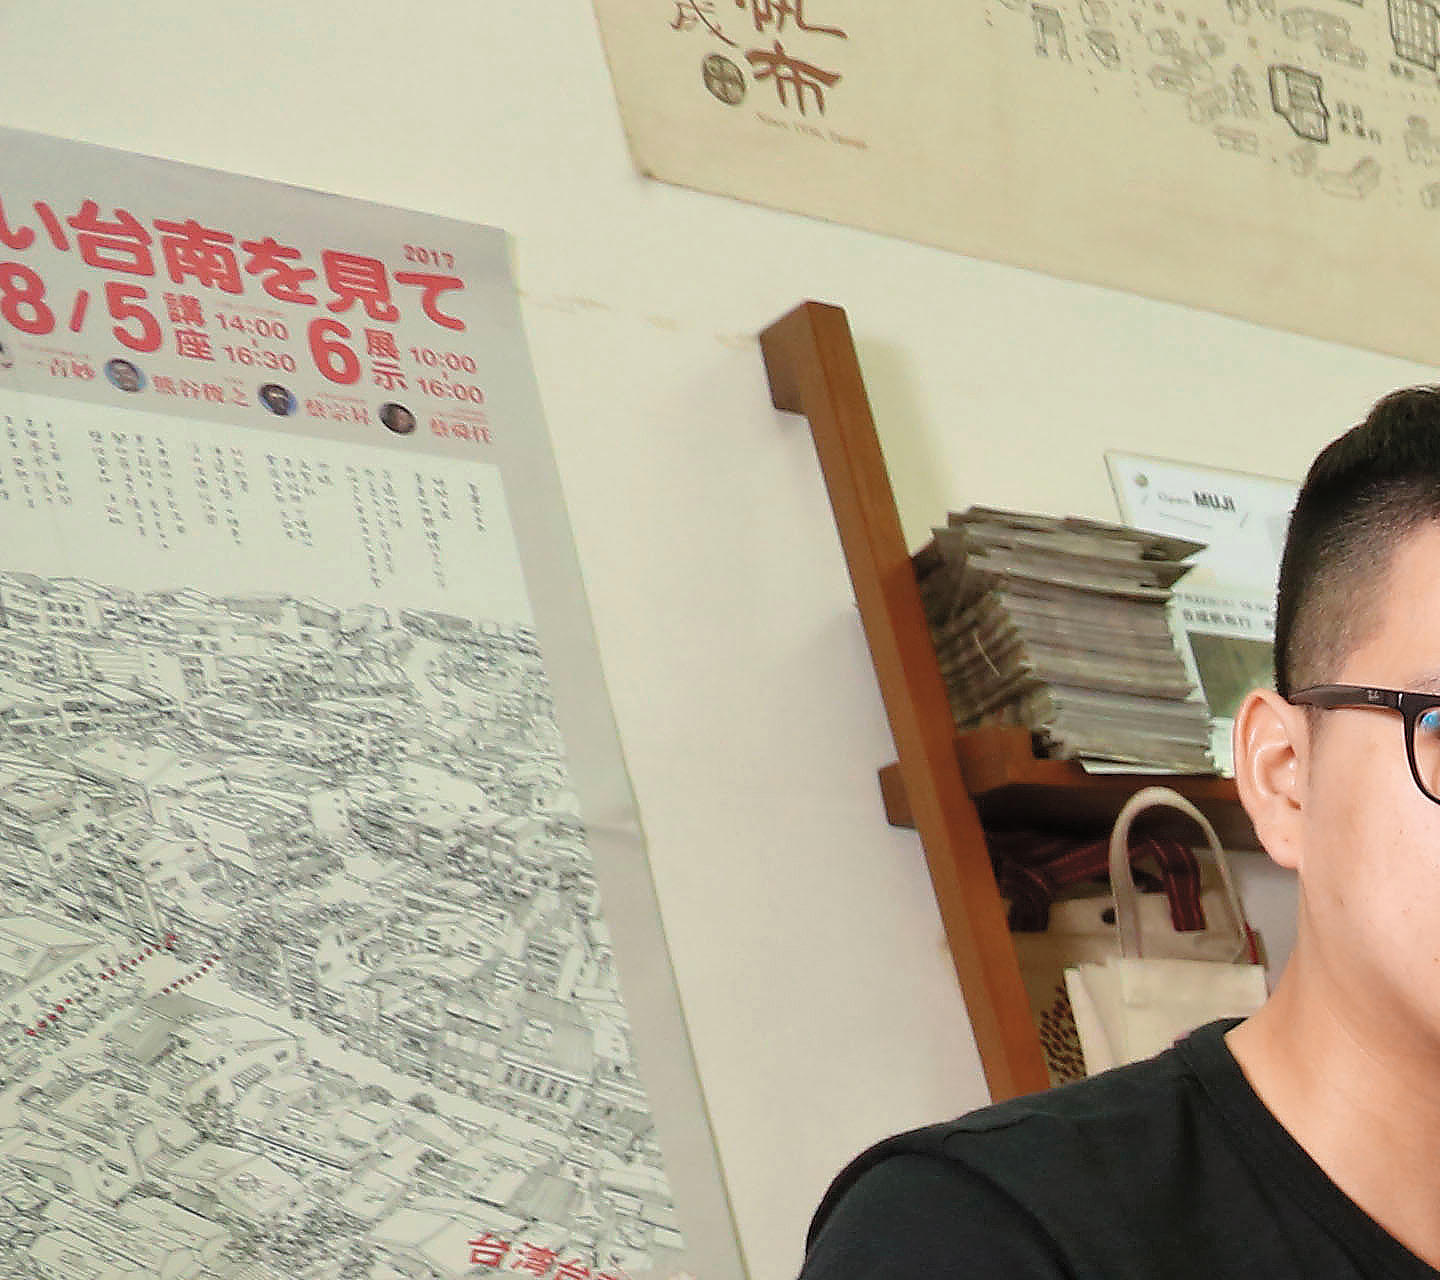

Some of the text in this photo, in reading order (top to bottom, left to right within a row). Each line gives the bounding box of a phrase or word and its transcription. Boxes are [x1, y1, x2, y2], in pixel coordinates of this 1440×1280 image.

[403, 244, 454, 268] 2017
[0, 261, 163, 353] 8/5
[215, 312, 289, 341] 14:00
[223, 343, 296, 373] 16:30
[307, 317, 361, 385] 6
[409, 346, 477, 375] 10:00
[416, 375, 485, 404] 16:00
[1193, 490, 1237, 513] MUJI
